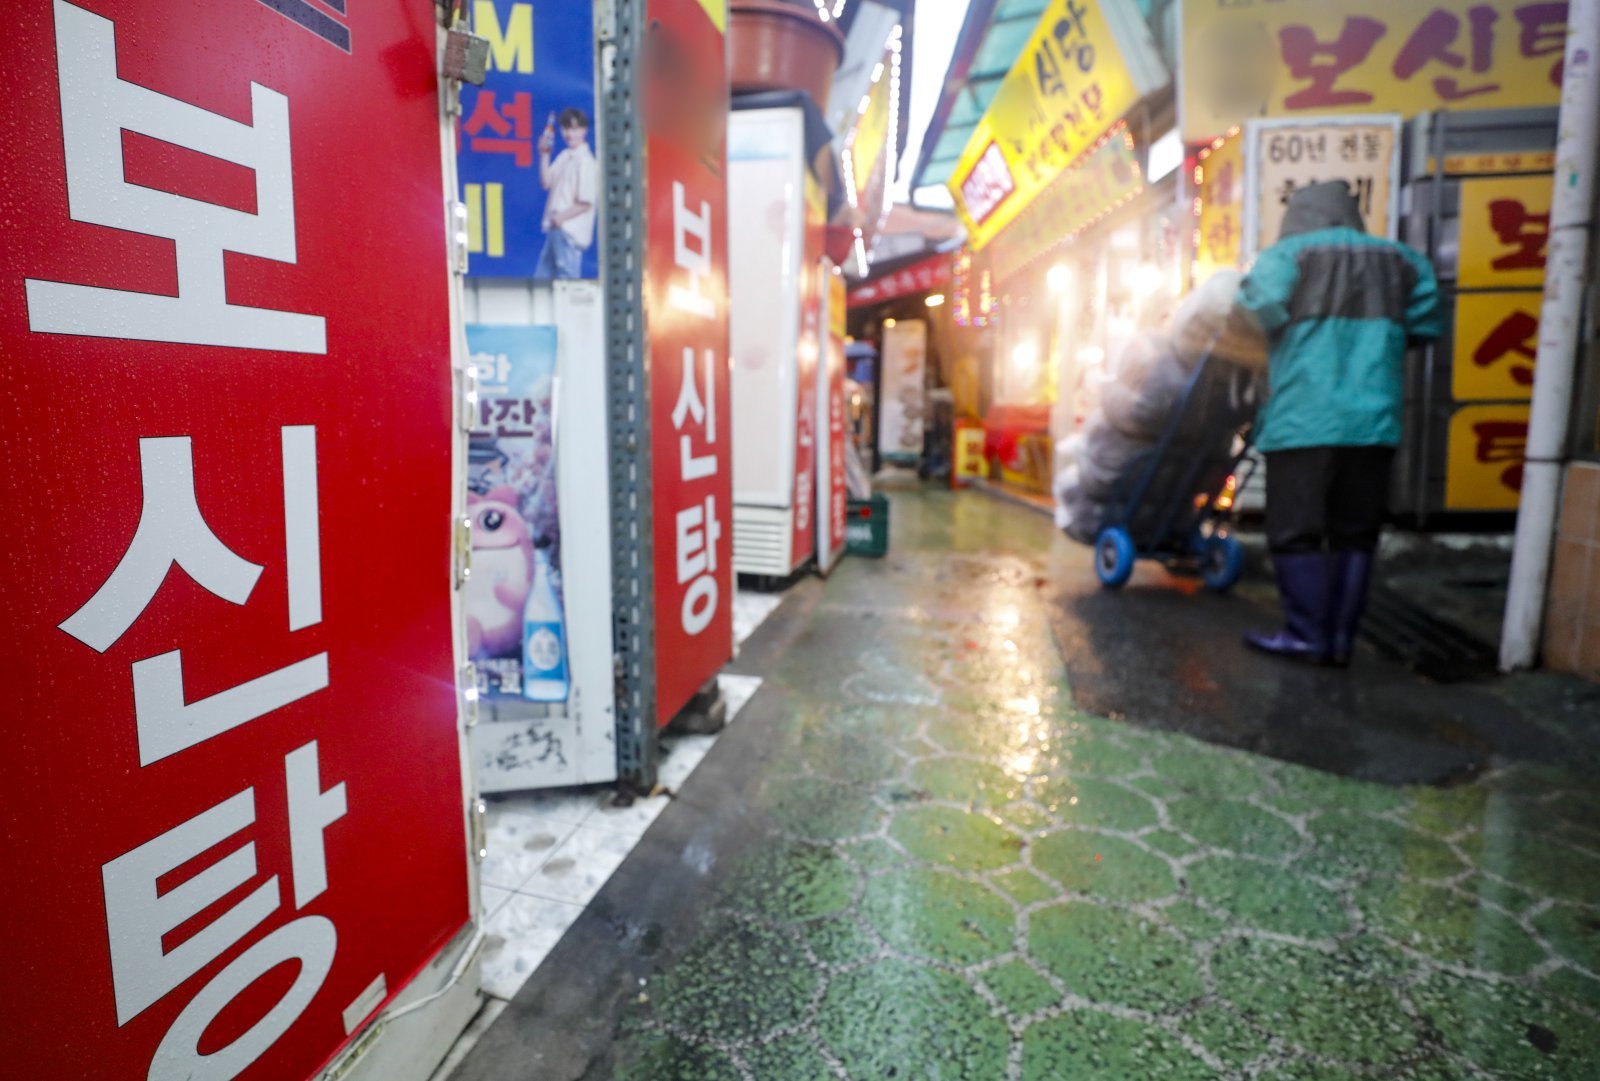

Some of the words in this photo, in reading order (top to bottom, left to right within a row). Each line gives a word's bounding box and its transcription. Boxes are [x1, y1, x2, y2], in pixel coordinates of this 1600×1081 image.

[455, 91, 533, 167] 석
[25, 0, 349, 1081] 보신탕
[669, 180, 721, 636] 보신탕
